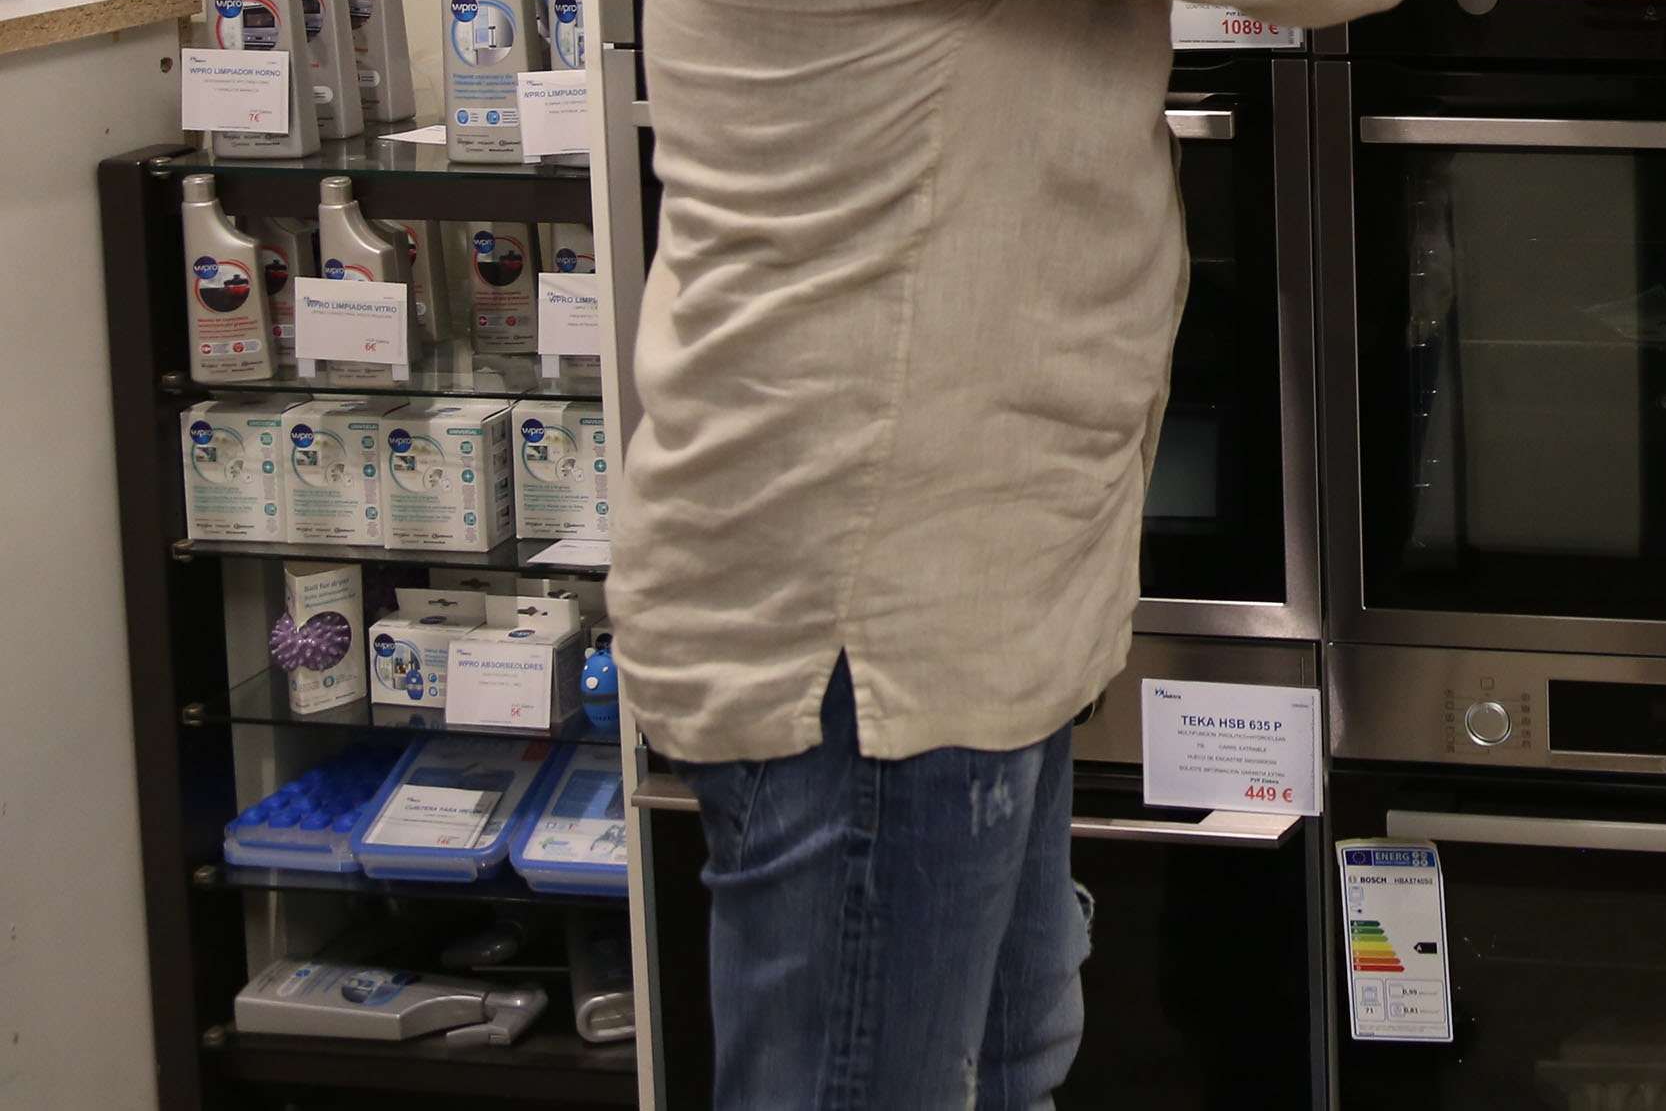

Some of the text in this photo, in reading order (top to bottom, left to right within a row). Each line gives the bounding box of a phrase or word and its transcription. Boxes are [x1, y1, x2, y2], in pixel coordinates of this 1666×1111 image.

[216, 0, 242, 10] wpro
[452, 2, 478, 13] wpro
[555, 3, 577, 14] wpro
[1222, 20, 1263, 34] 1089
[214, 67, 253, 75] LIMPIADOR
[255, 69, 281, 77] HORNO
[194, 265, 219, 273] wpro
[326, 266, 345, 275] wpro
[331, 302, 373, 312] LIMPIADOR
[375, 304, 398, 313] VITRO
[190, 429, 213, 439] wpro
[291, 432, 314, 441] wpro
[522, 427, 545, 436] wpro
[389, 436, 412, 446] wpro
[375, 642, 395, 650] wpro
[1181, 715, 1282, 731] TEKA HSB 635 P
[1244, 785, 1293, 803] 449 €
[1375, 852, 1410, 861] ENERG
[1360, 876, 1387, 884] BOSCH
